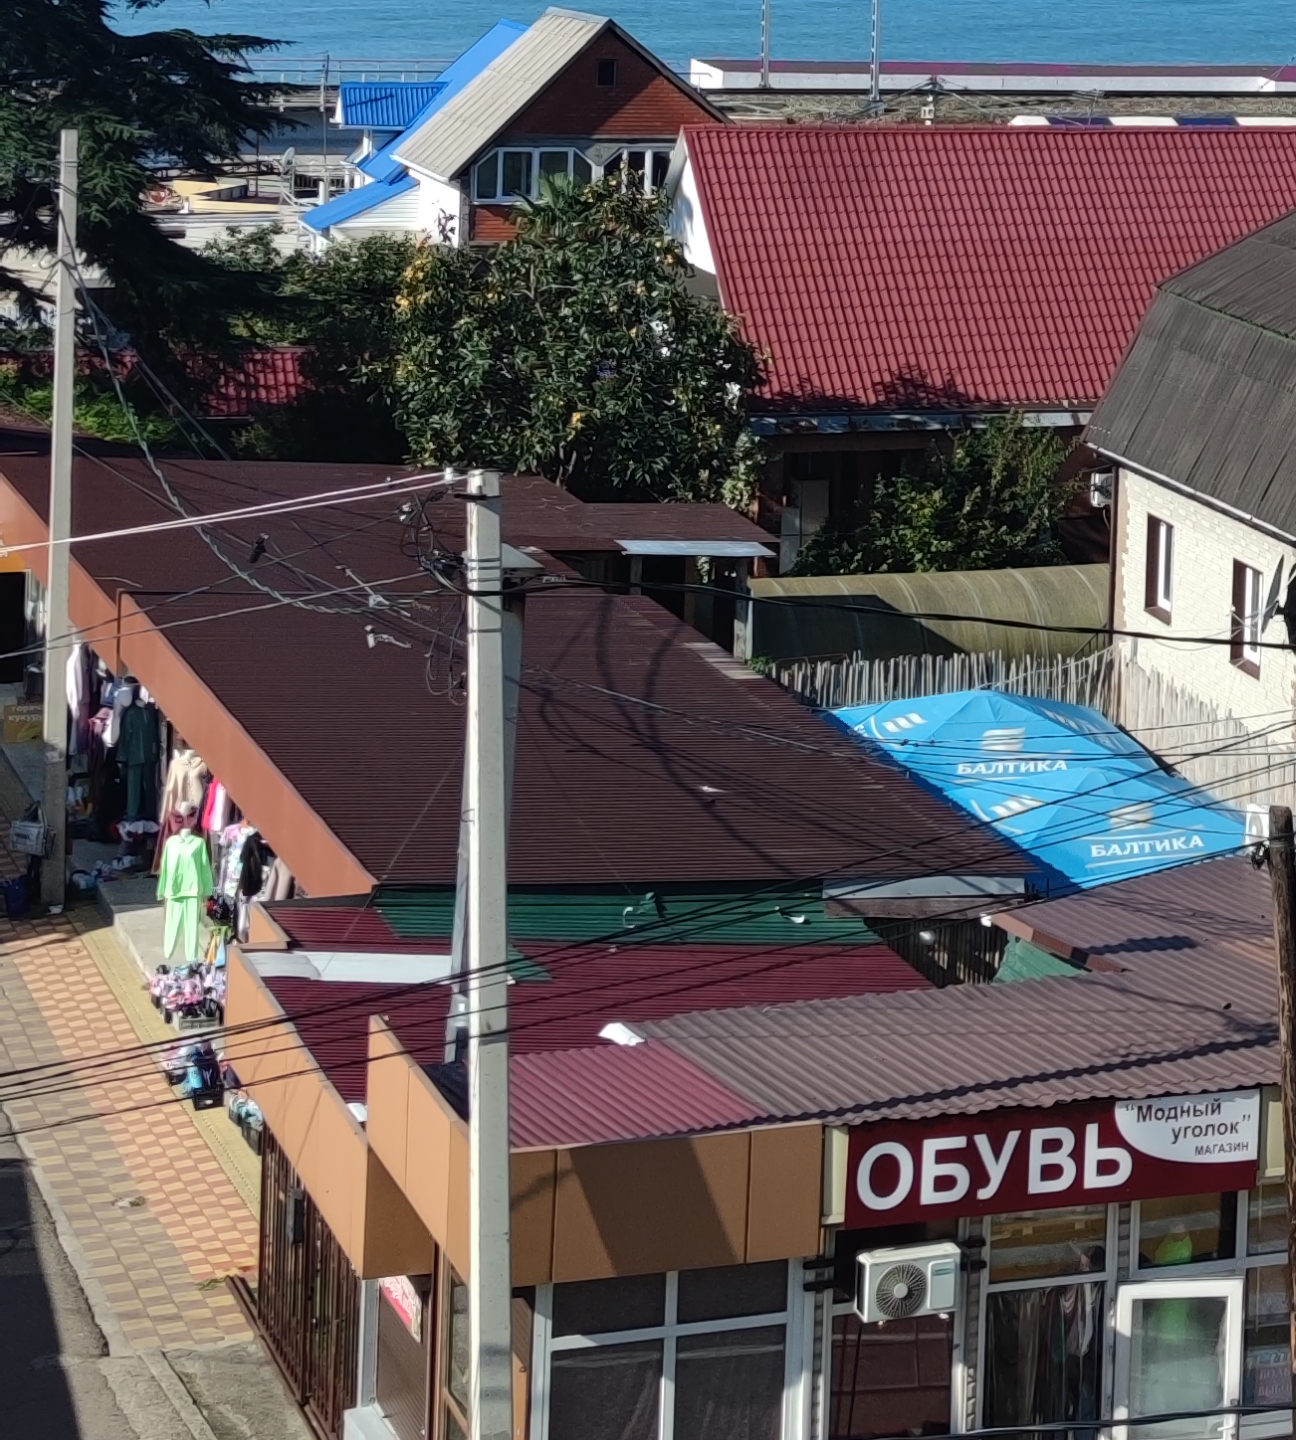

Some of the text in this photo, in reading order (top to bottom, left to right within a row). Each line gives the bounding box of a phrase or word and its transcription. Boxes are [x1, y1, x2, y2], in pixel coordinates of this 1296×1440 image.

[956, 759, 1069, 776] БАЛТИКА
[1089, 833, 1206, 859] БАЛТИКА
[1194, 1141, 1249, 1156] МАГАЗИН
[856, 1122, 1133, 1211] ОБУВЬ
